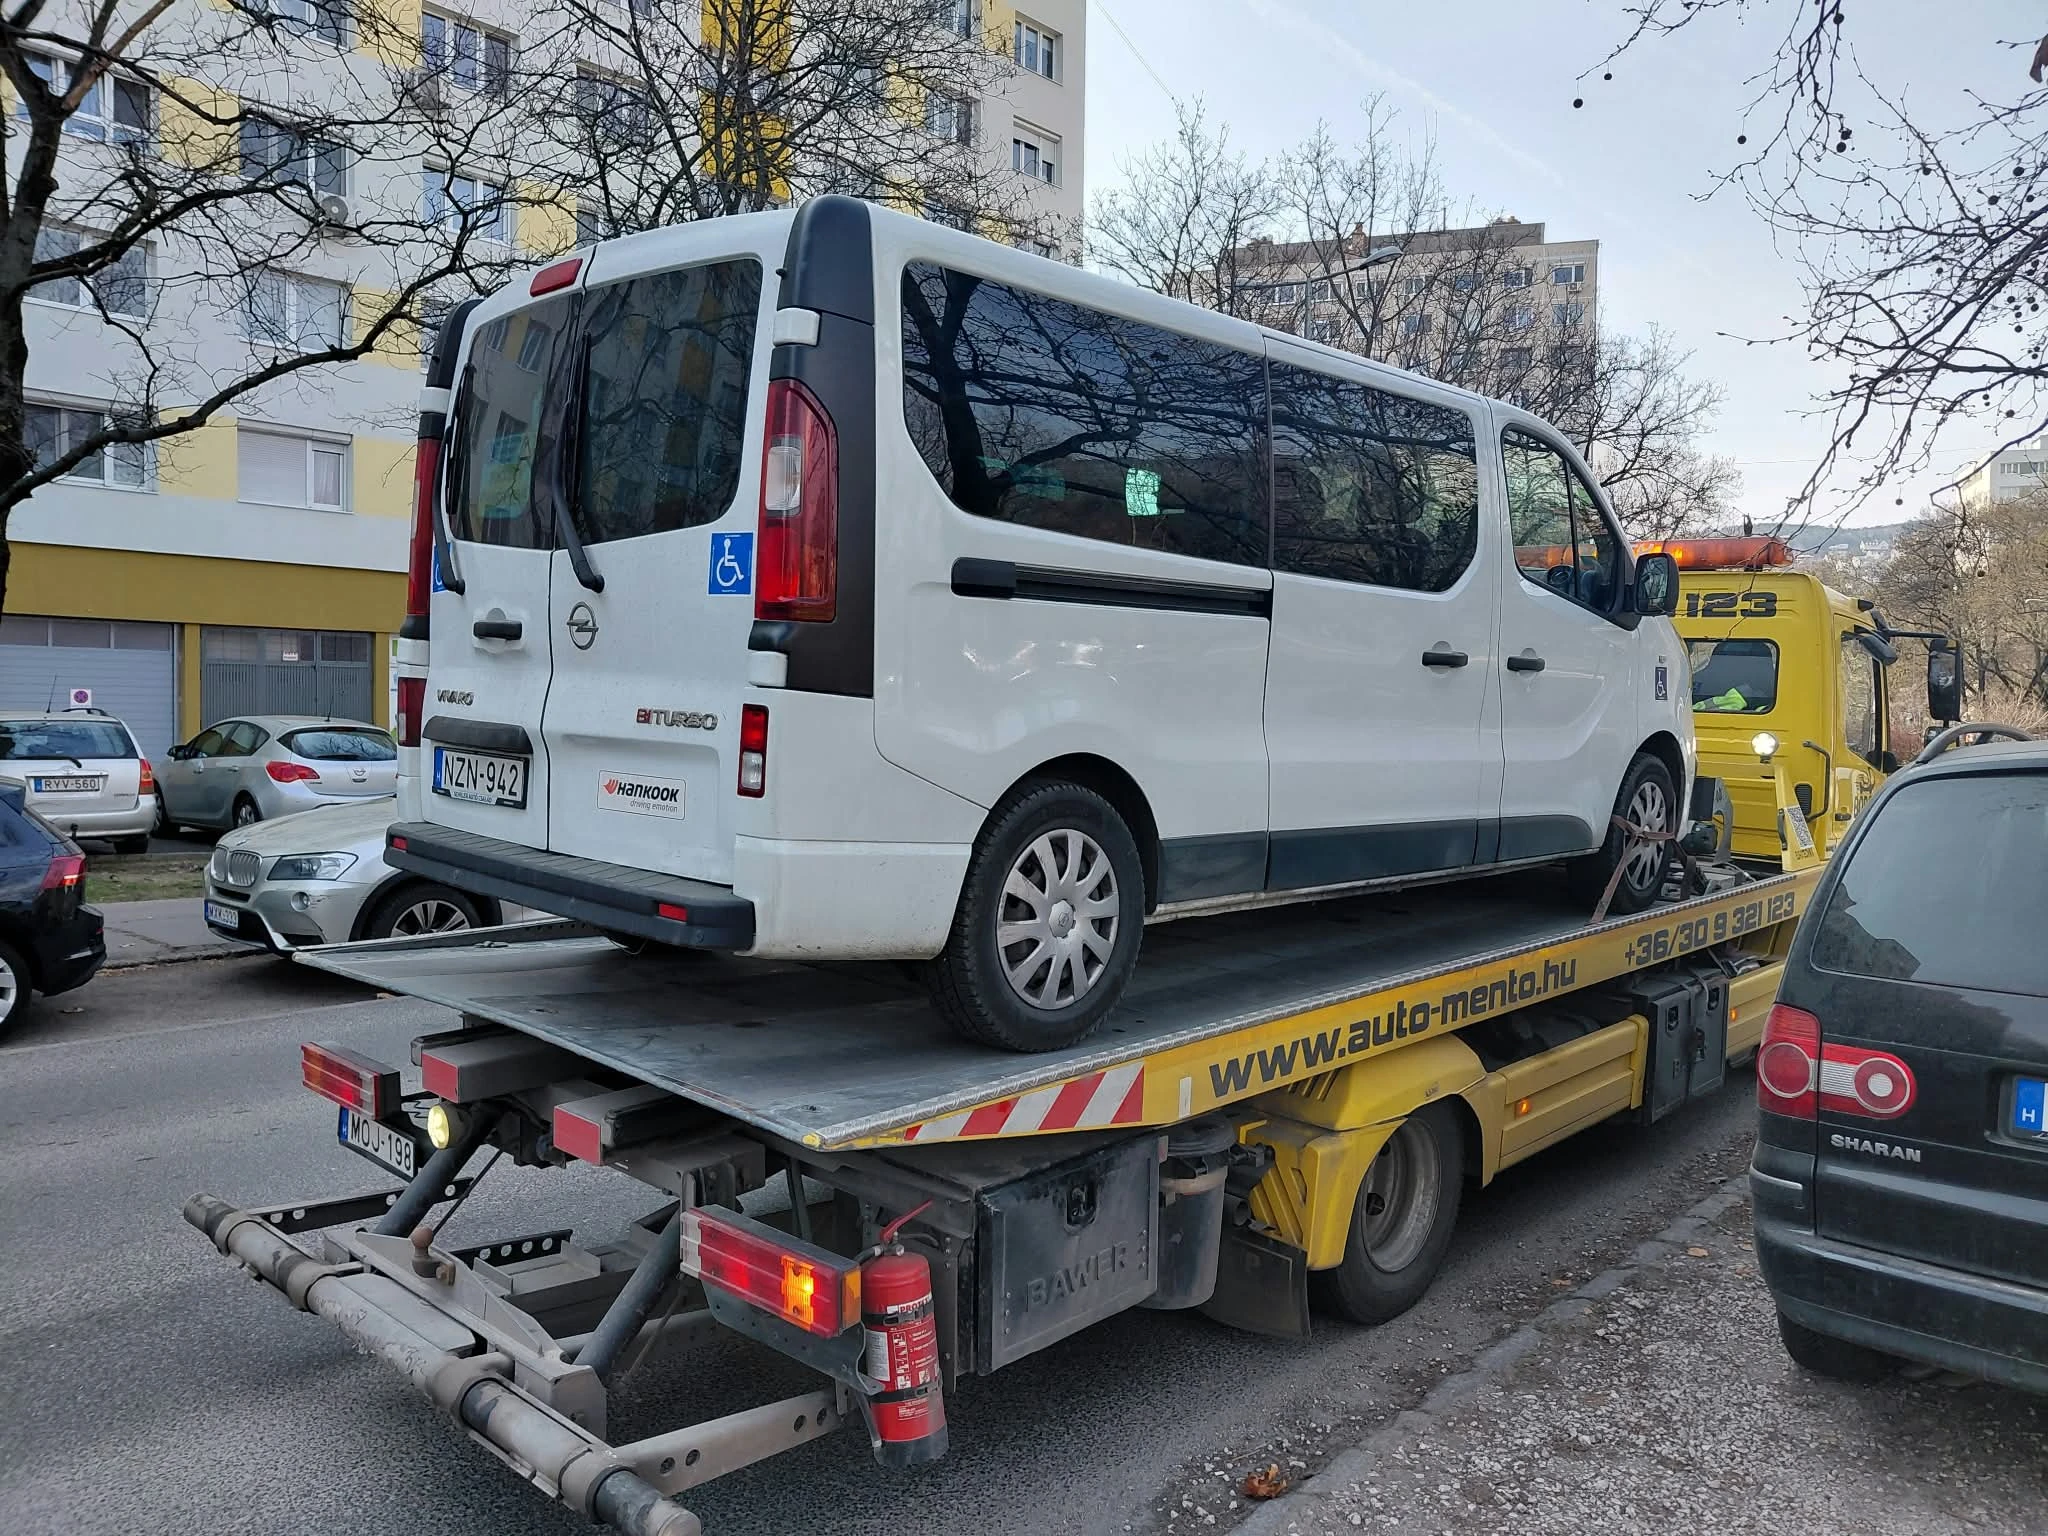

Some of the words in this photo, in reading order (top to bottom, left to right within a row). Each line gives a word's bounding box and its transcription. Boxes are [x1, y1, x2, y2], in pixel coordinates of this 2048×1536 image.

[437, 689, 475, 706] VIVARO
[636, 708, 719, 731] BITURBO
[44, 779, 96, 790] RYV-560
[444, 755, 518, 797] NZN-942
[630, 799, 651, 811] driving
[651, 803, 678, 813] emotion
[1625, 917, 1708, 966] +36/30
[1714, 911, 1728, 941] 9
[1731, 900, 1763, 935] 321
[1767, 891, 1796, 923] 123
[1208, 958, 1577, 1098] www.auto-mento.hu
[2022, 1107, 2036, 1123] H
[350, 1112, 412, 1171] MOJ-198
[1830, 1134, 1921, 1163] SHARAN
[1026, 1240, 1130, 1312] BAWER
